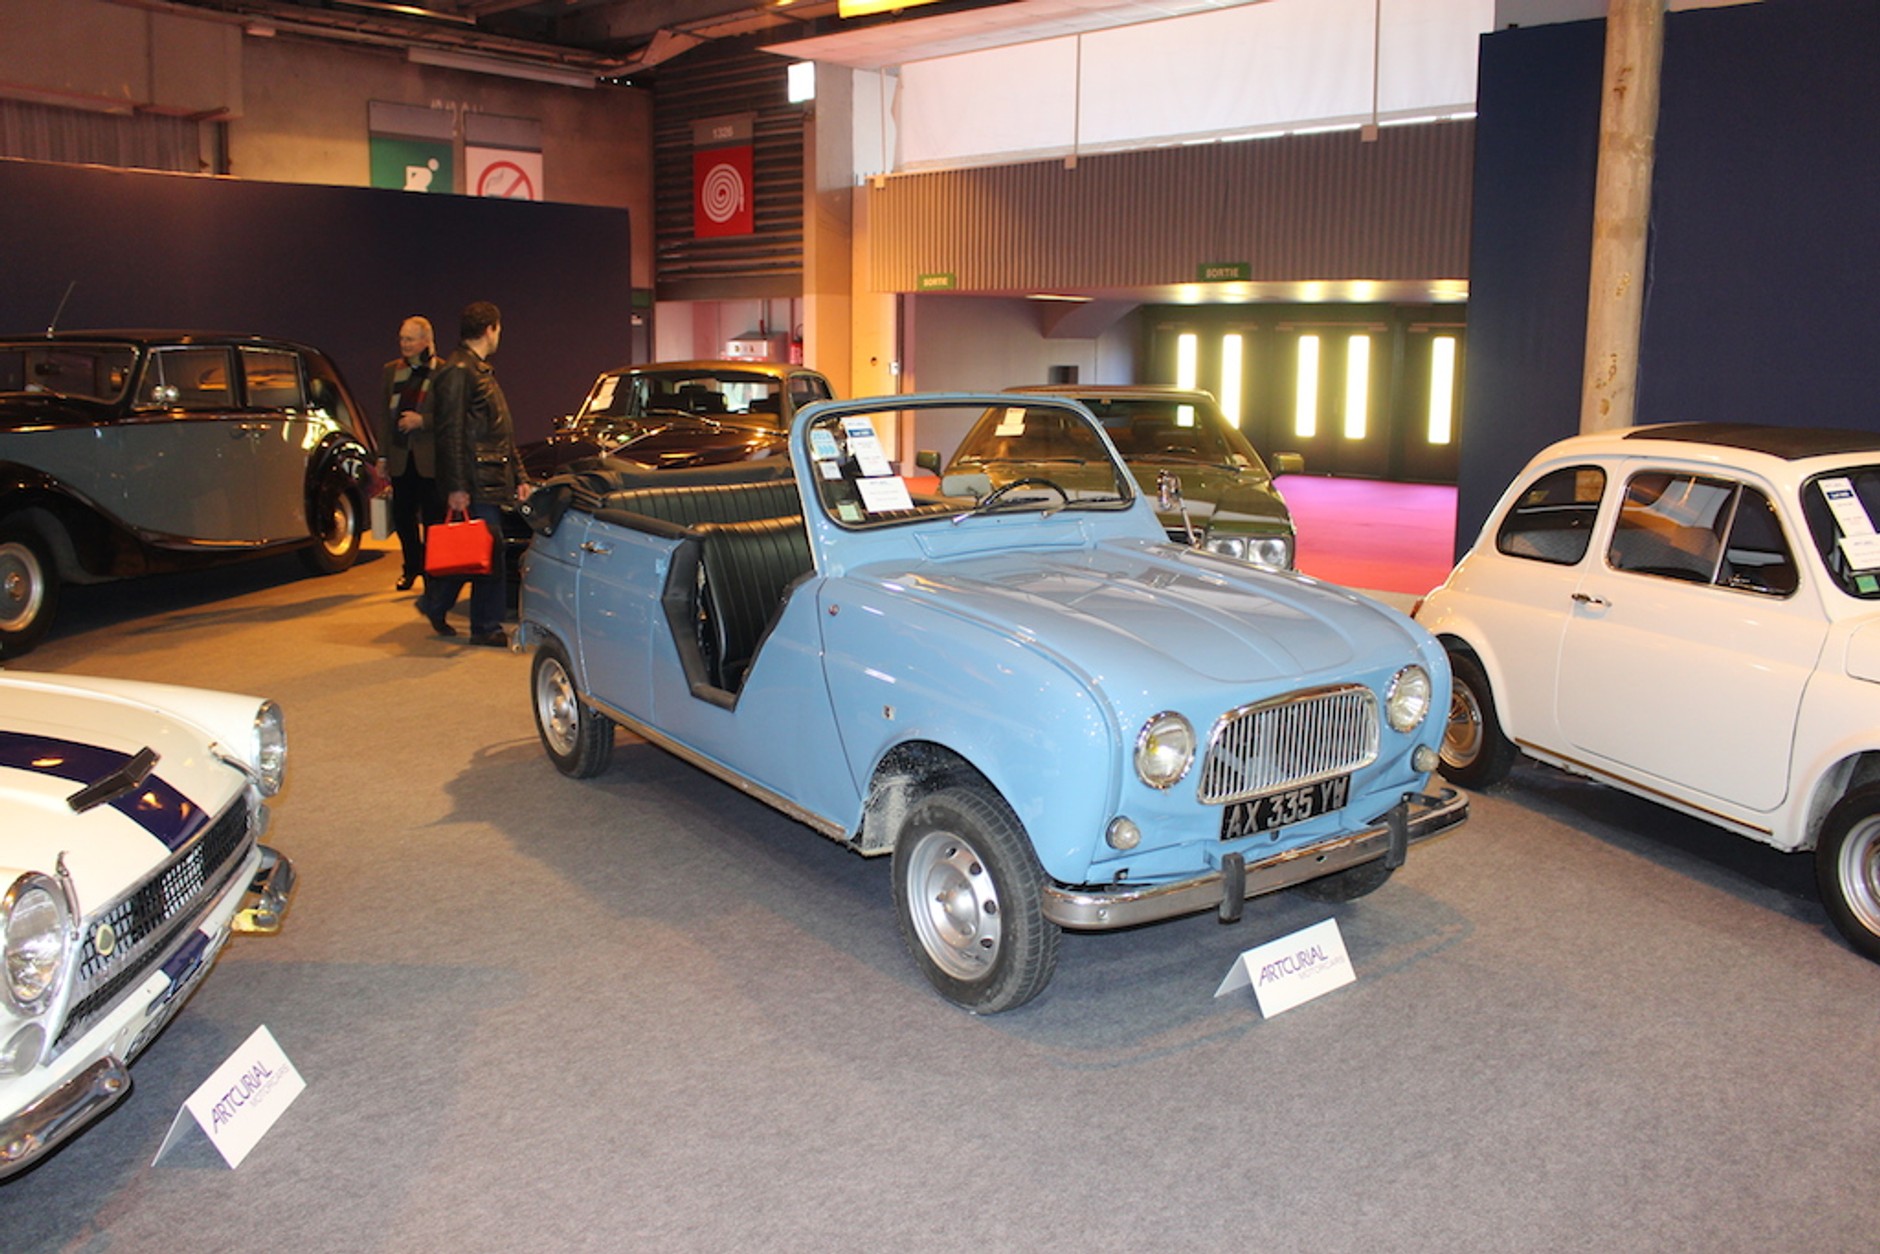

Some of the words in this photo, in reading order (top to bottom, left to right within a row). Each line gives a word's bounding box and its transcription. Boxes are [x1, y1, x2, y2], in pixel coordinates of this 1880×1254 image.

[923, 276, 948, 287] SORTIE
[1206, 267, 1239, 279] SORTIE
[1227, 802, 1262, 837] AX
[1267, 787, 1314, 827] 335
[1258, 944, 1328, 987] ARTCURIAL
[211, 1060, 273, 1134] ARTCURIAL
